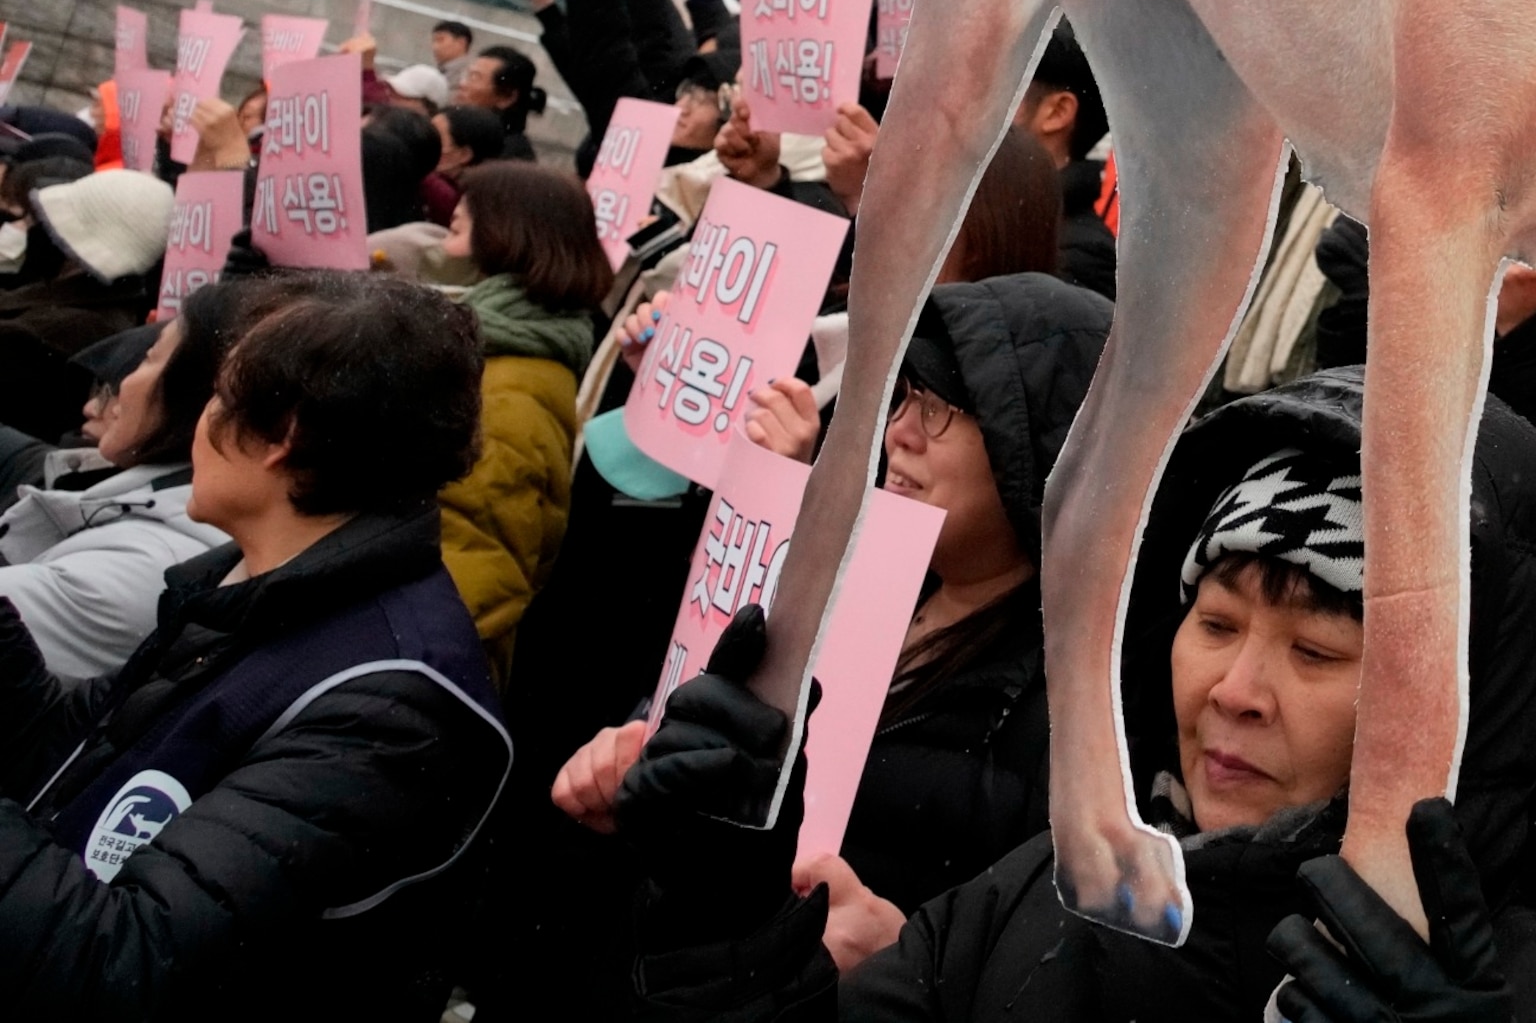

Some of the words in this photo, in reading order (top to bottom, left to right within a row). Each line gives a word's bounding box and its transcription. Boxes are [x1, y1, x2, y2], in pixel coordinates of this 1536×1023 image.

[177, 36, 211, 79] 바이
[751, 37, 774, 99] 개
[775, 37, 833, 104] 식용!
[265, 89, 329, 154] 굿바이
[597, 125, 641, 177] 바이
[170, 200, 212, 253] 바이
[255, 177, 279, 235] 개
[282, 172, 348, 235] 식용!
[594, 189, 629, 240] 용!
[682, 221, 778, 324] 바이
[655, 323, 754, 433] 식용!
